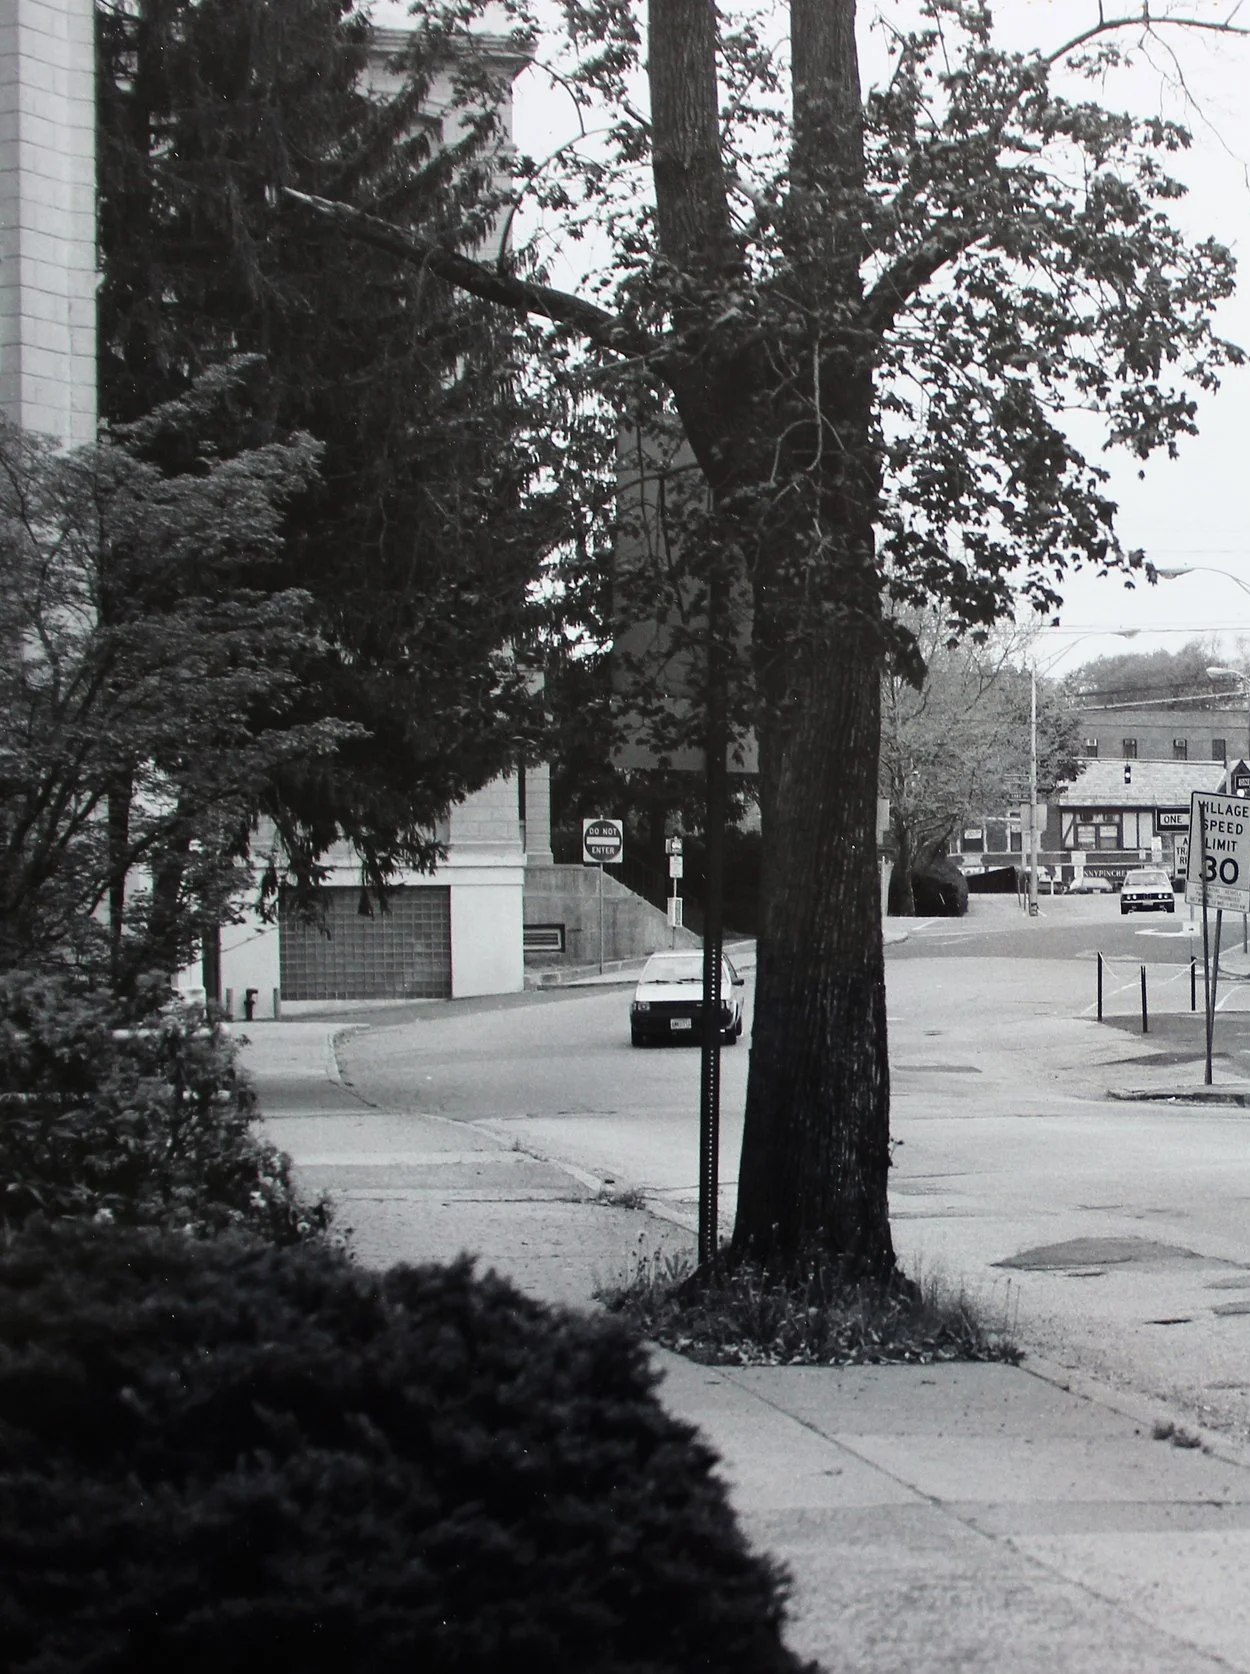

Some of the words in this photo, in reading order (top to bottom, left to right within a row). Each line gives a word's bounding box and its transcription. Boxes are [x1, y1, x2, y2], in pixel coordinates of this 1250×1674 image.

[1239, 778, 1250, 787] ONE
[1198, 800, 1250, 818] VILLAGE
[1163, 815, 1183, 824] ONE
[589, 827, 600, 835] DO
[602, 827, 617, 836] NOT
[1203, 818, 1244, 836] SPEED
[591, 846, 615, 855] ENTER
[1205, 839, 1238, 853] LIMIT
[1199, 855, 1239, 885] 30
